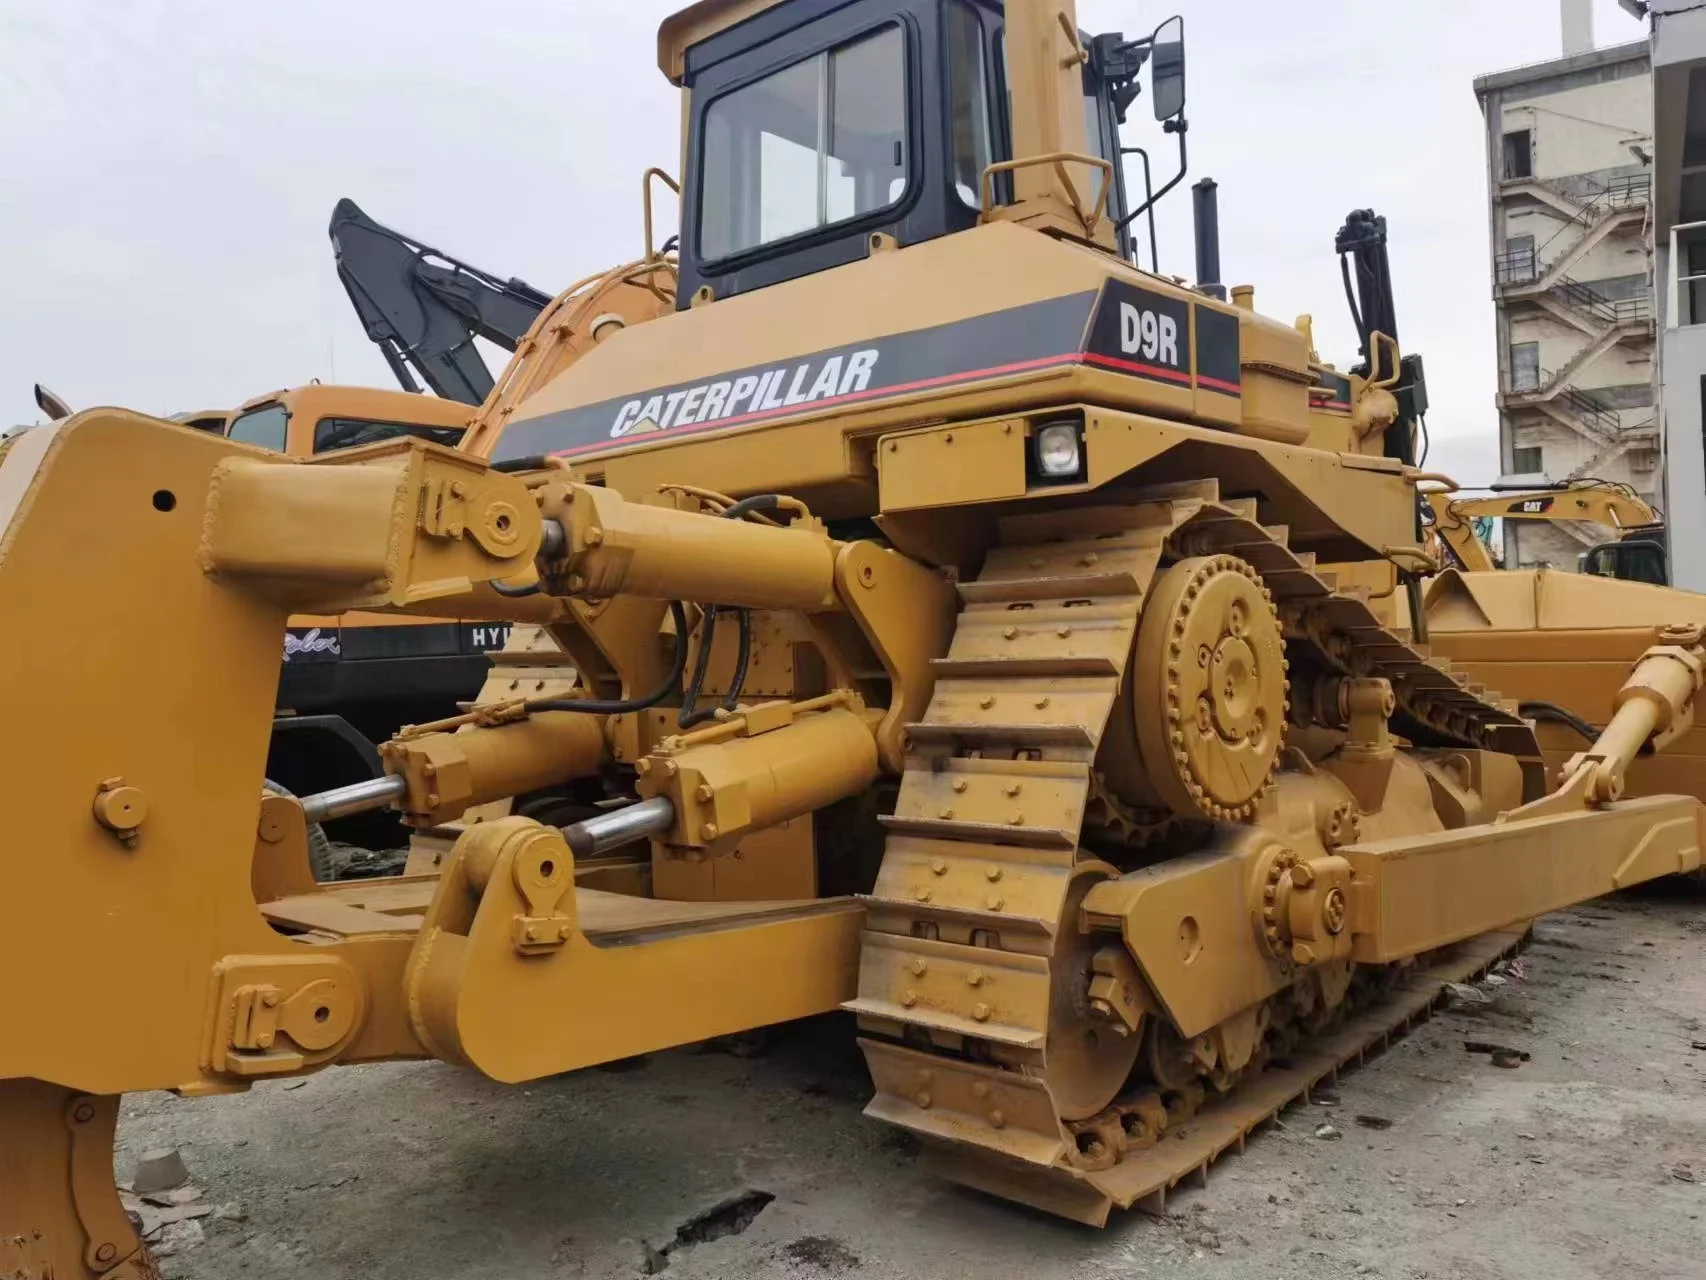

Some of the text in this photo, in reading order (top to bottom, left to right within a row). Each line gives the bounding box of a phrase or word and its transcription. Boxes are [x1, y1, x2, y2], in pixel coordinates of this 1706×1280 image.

[1120, 301, 1178, 366] D9R
[609, 349, 880, 438] CATERPILLAR
[1524, 501, 1542, 512] CAT
